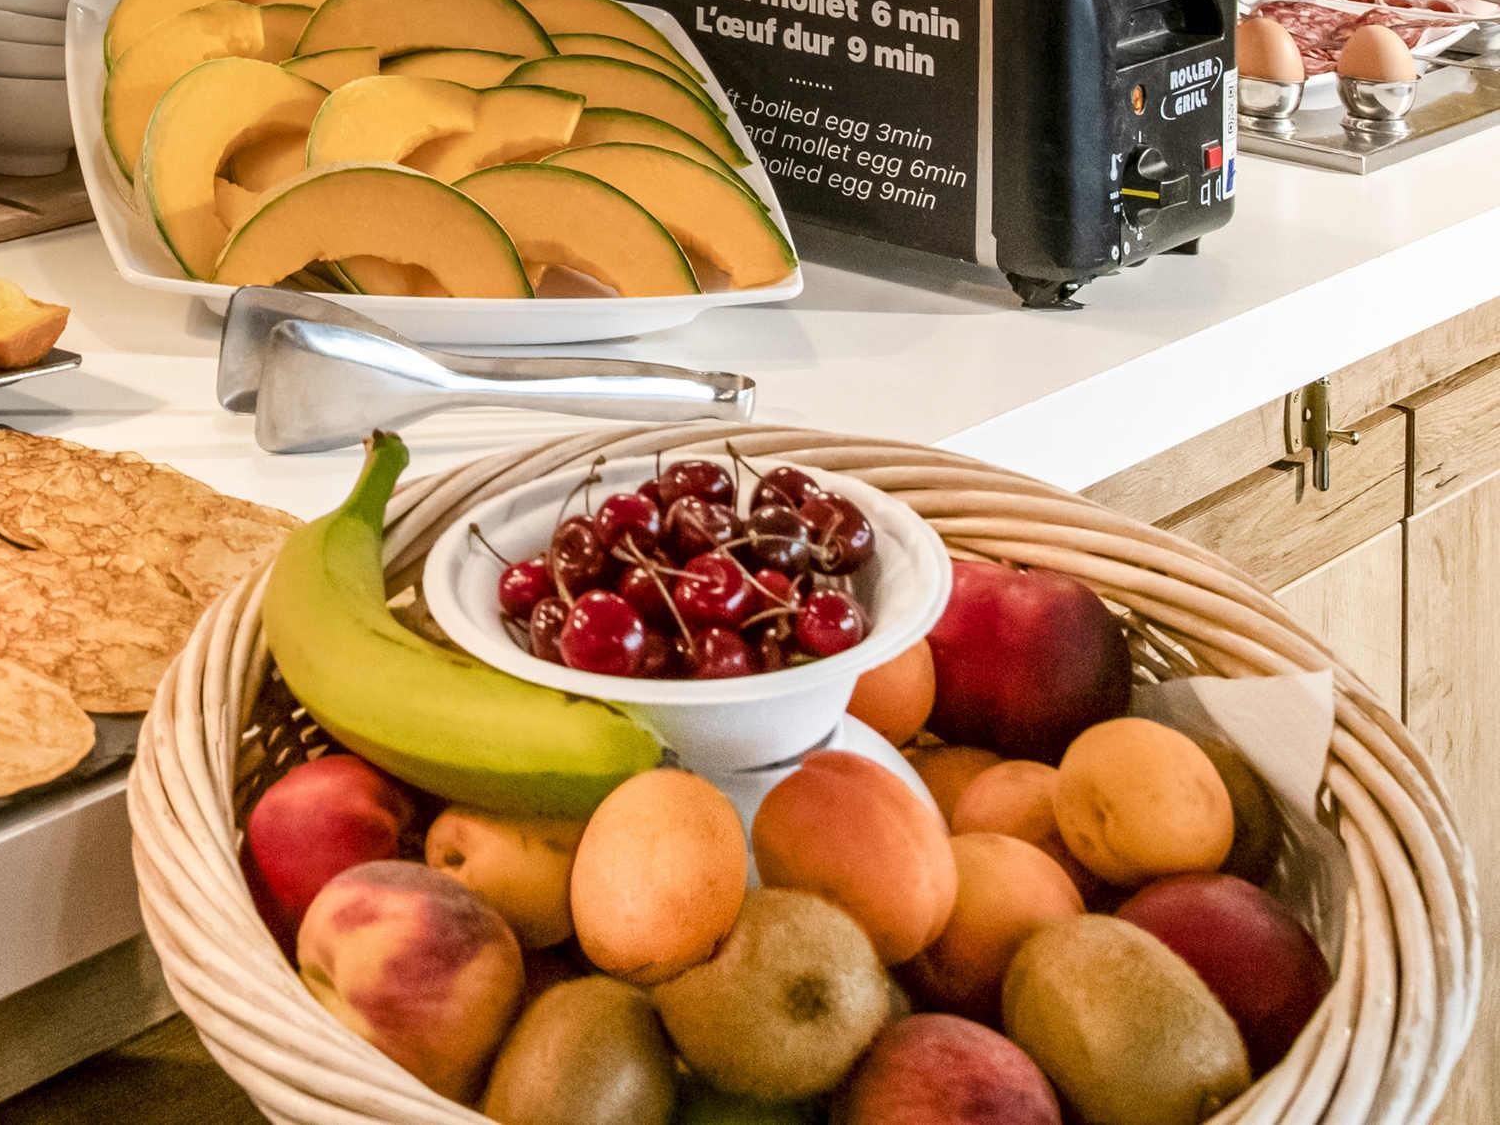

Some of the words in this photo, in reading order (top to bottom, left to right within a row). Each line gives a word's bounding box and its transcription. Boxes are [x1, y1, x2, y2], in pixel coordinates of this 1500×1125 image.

[871, 0, 892, 28] 6
[898, 6, 961, 41] min
[783, 22, 835, 57] dur
[847, 36, 868, 63] 9
[874, 43, 936, 77] min
[1169, 58, 1214, 91] ROLLER
[1175, 88, 1208, 116] GRILL
[825, 115, 870, 143] egg
[876, 123, 933, 152] 3min
[781, 133, 852, 163] mollet
[856, 150, 903, 179] egg
[909, 159, 968, 189] 6min
[828, 172, 873, 201] egg
[879, 181, 937, 211] 9min
